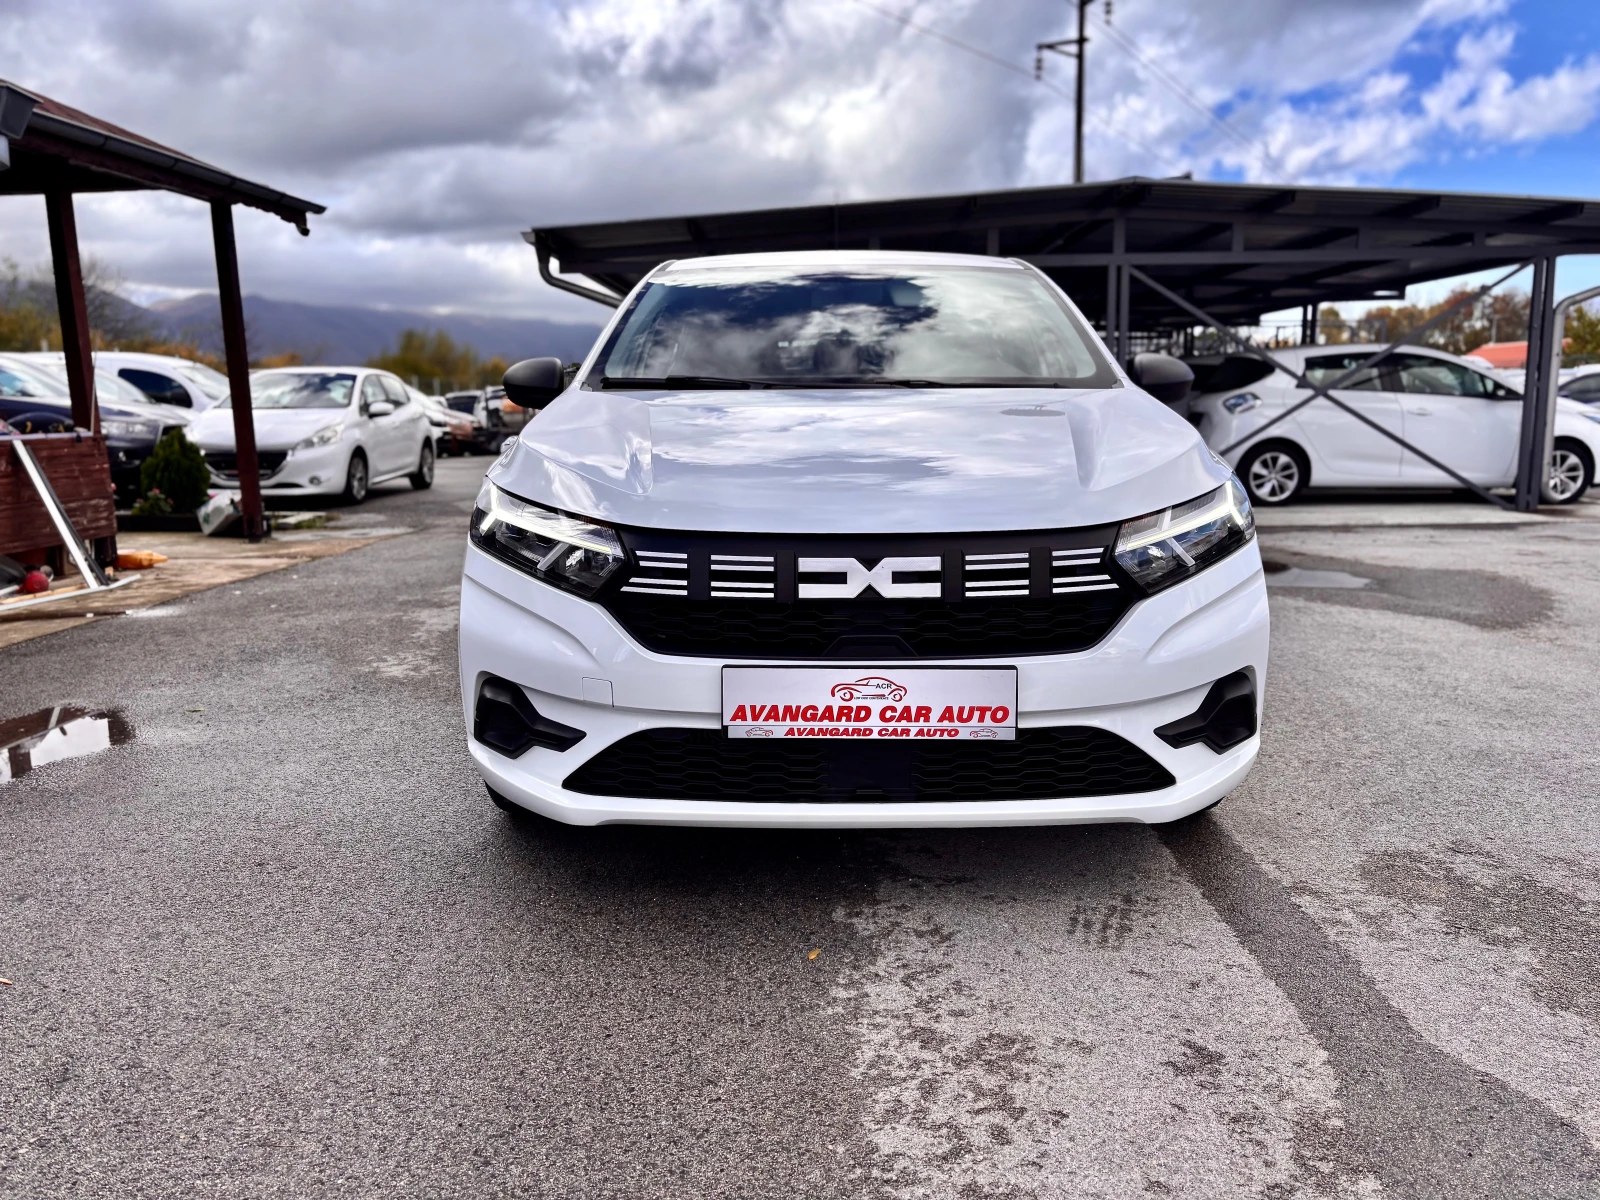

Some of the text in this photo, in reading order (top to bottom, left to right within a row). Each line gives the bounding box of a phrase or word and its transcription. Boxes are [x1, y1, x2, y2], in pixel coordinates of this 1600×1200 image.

[729, 704, 1010, 724] AVANGARD CAR AUTO
[783, 727, 960, 738] AVANGARD CAR AUTO
